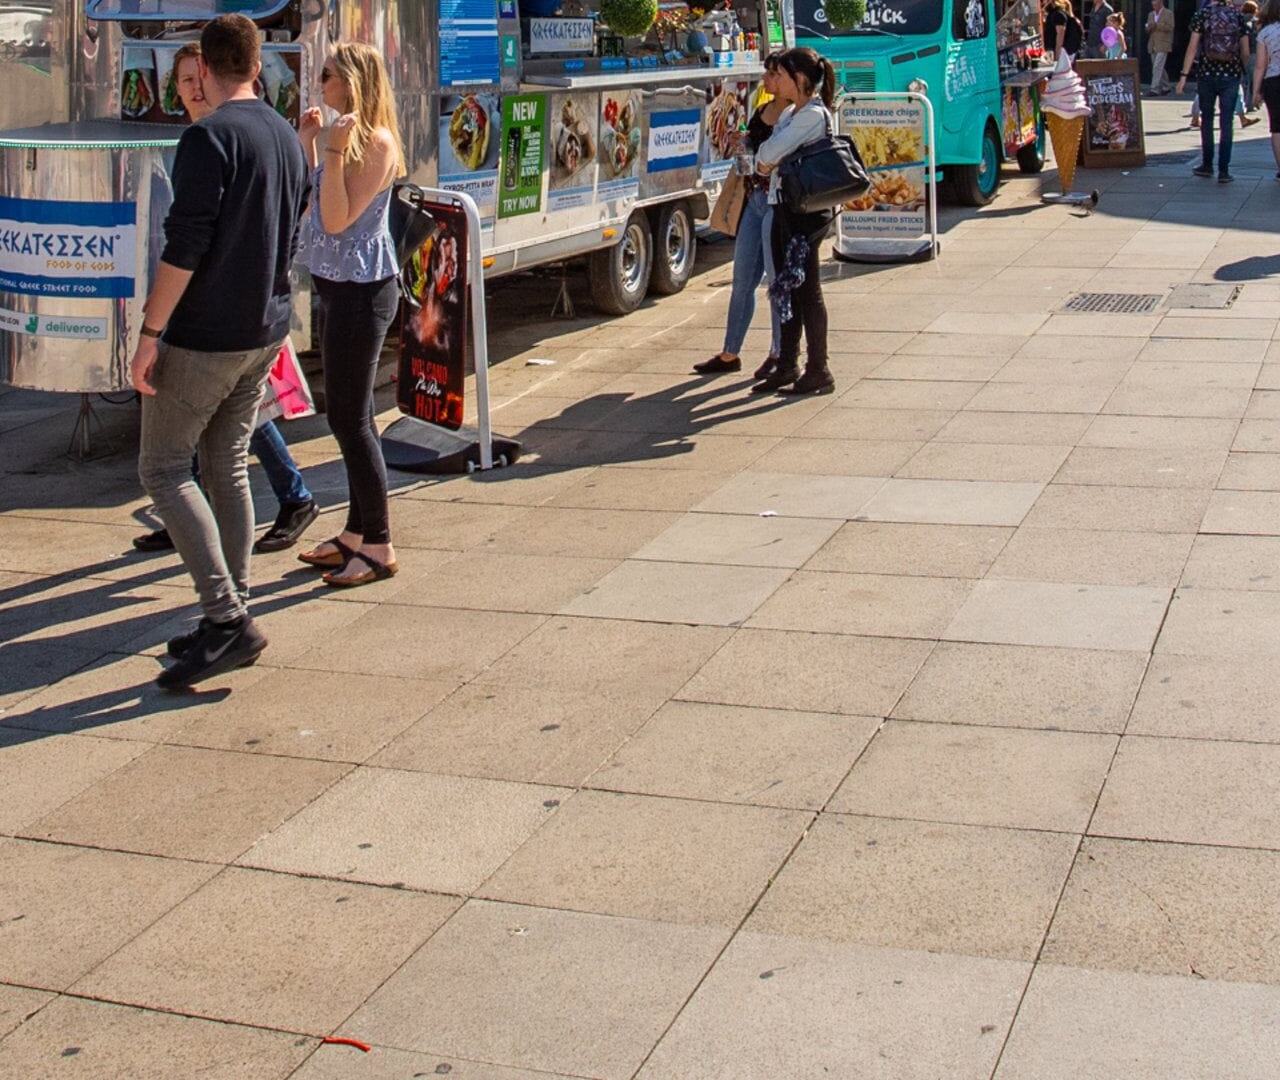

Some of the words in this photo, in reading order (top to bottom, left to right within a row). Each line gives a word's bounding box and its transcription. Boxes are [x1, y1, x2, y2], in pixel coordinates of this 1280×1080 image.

[513, 102, 537, 121] NEW
[842, 108, 894, 117] GREEKitaze
[896, 107, 920, 117] chips
[503, 197, 518, 213] TRY
[518, 195, 538, 210] NOW
[46, 259, 72, 269] FOOD
[74, 261, 86, 271] OF
[90, 261, 116, 271] GODS
[19, 281, 40, 291] GREEK
[42, 283, 71, 293] STREET
[73, 285, 98, 294] FOOD
[45, 321, 100, 334] deliveroo
[412, 357, 449, 385] VOLCANO
[415, 394, 442, 423] HOT
